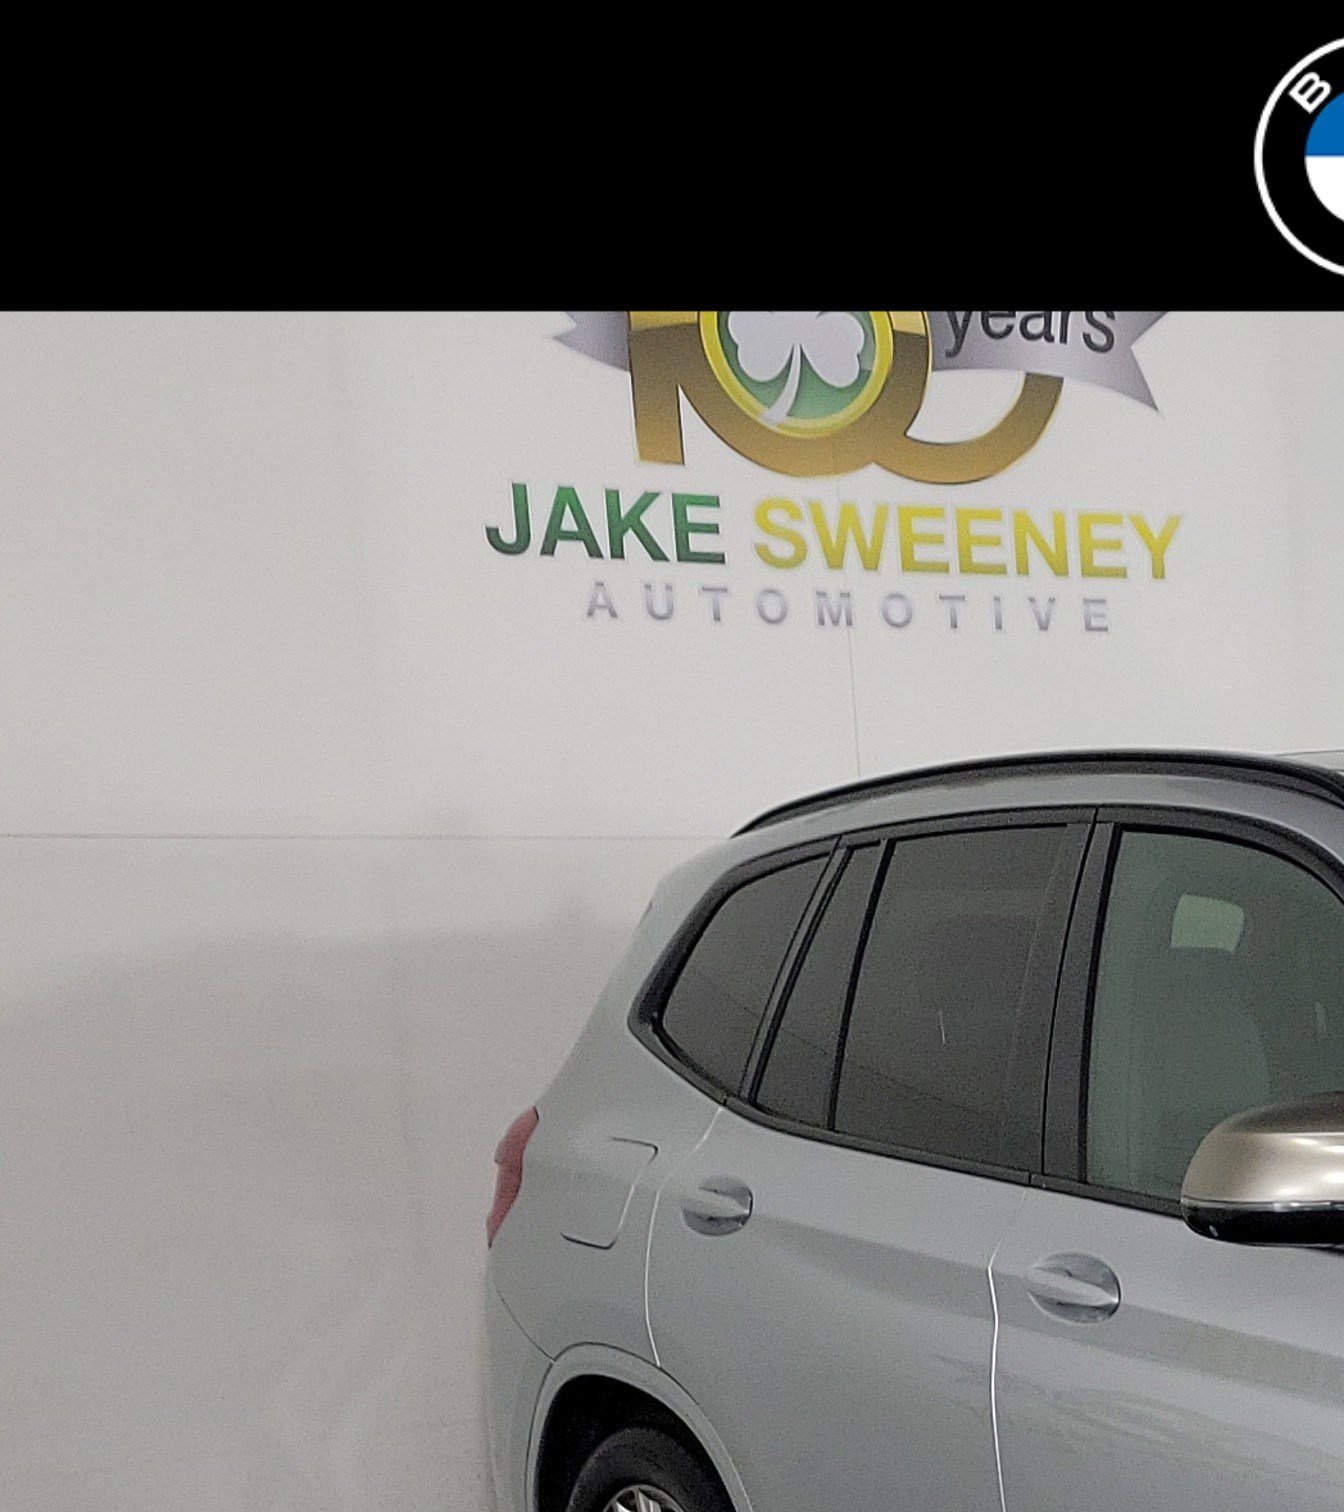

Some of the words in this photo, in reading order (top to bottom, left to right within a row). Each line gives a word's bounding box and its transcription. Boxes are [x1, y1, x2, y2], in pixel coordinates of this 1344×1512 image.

[484, 482, 726, 565] JAKE
[753, 497, 1181, 579] SWEENEY
[586, 581, 1110, 632] AUTOMOTIVE
